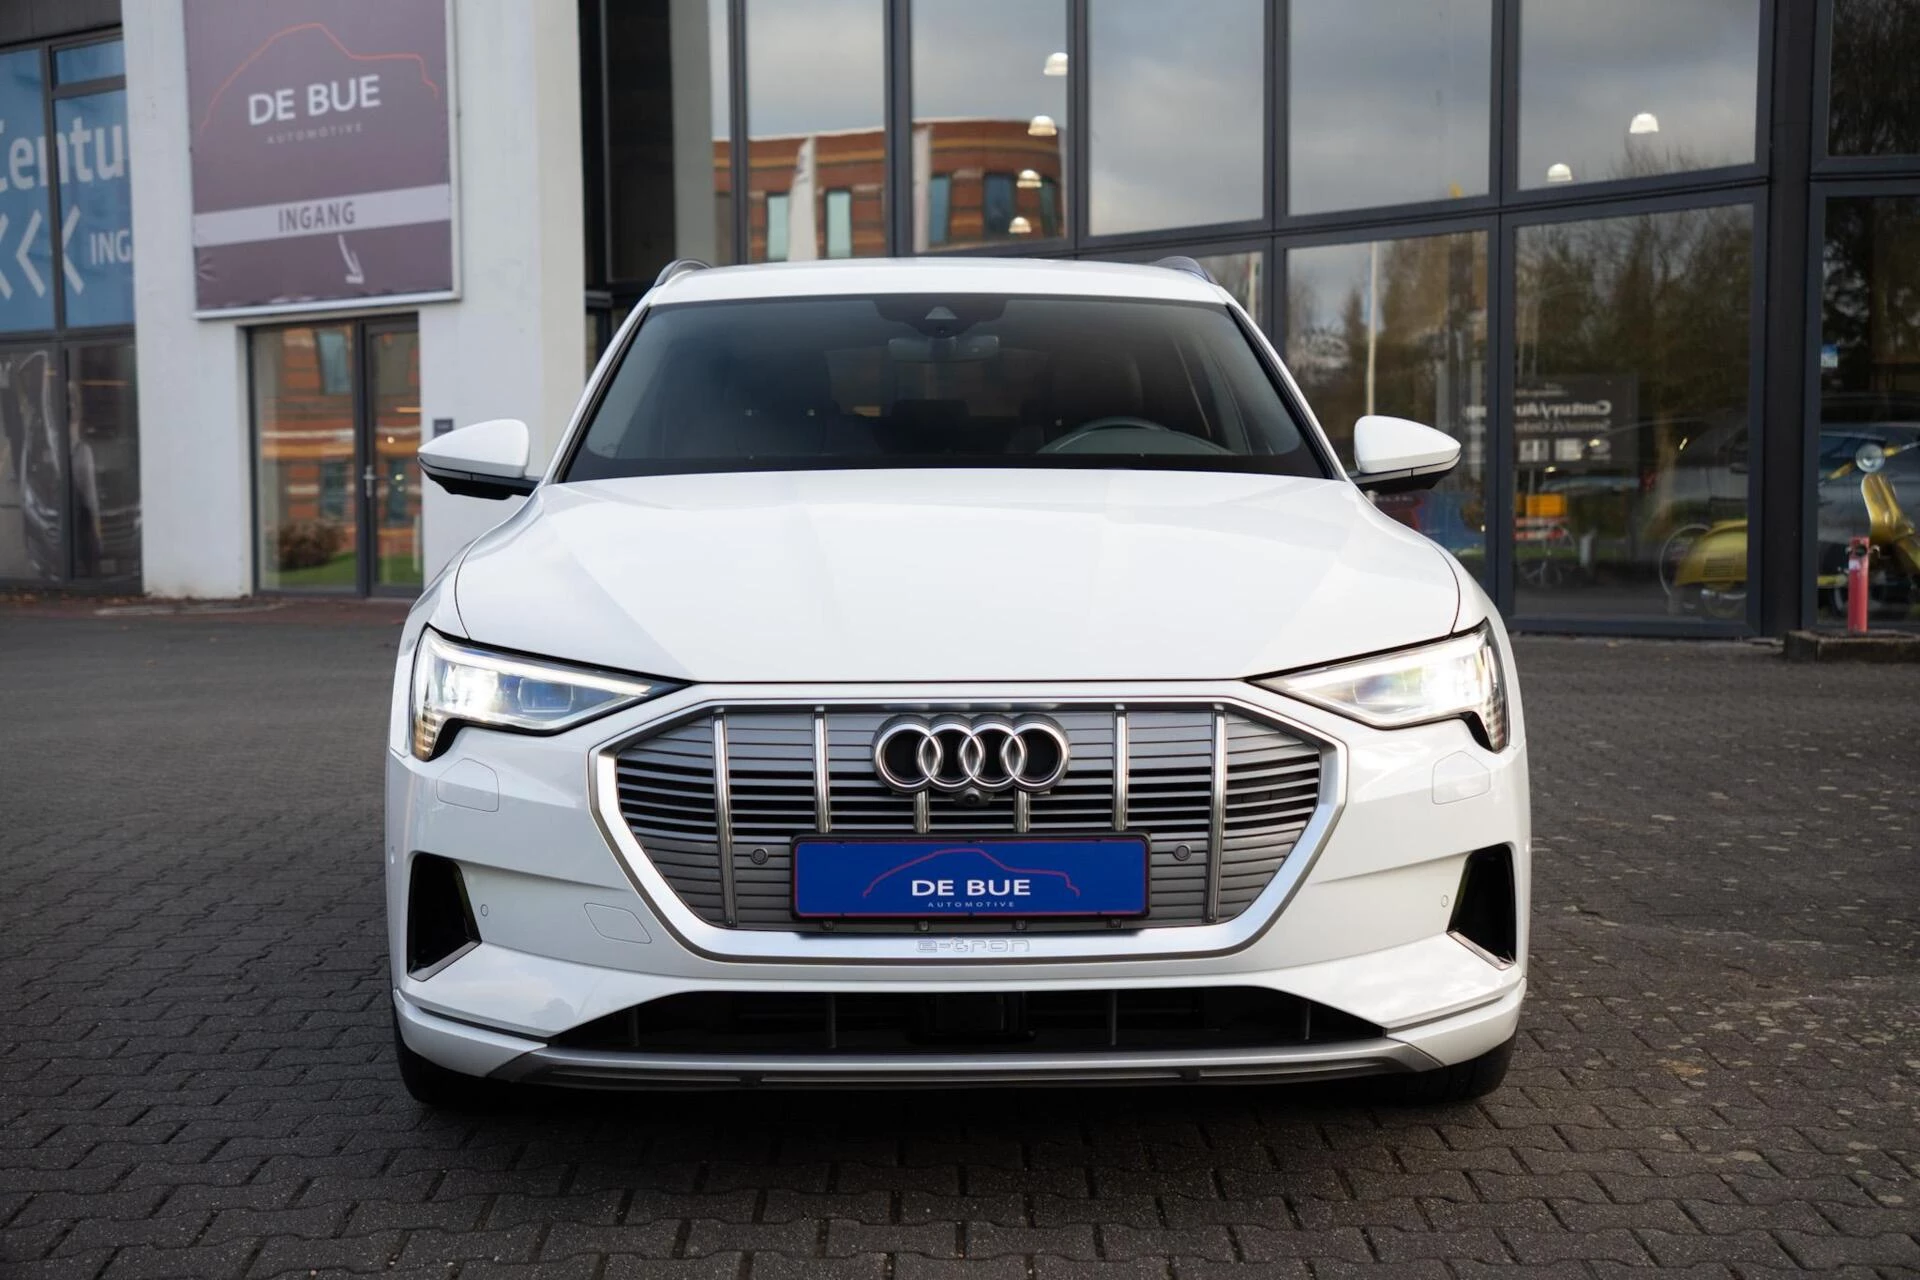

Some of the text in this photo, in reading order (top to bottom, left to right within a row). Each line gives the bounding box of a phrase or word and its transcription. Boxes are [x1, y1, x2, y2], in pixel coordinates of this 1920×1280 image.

[249, 74, 381, 126] DE BUE
[266, 122, 362, 145] AUTOMOTIVE
[0, 117, 124, 192] entu
[278, 200, 356, 233] INGANG
[911, 879, 1031, 896] DE BUE
[917, 936, 1030, 953] e-tron
